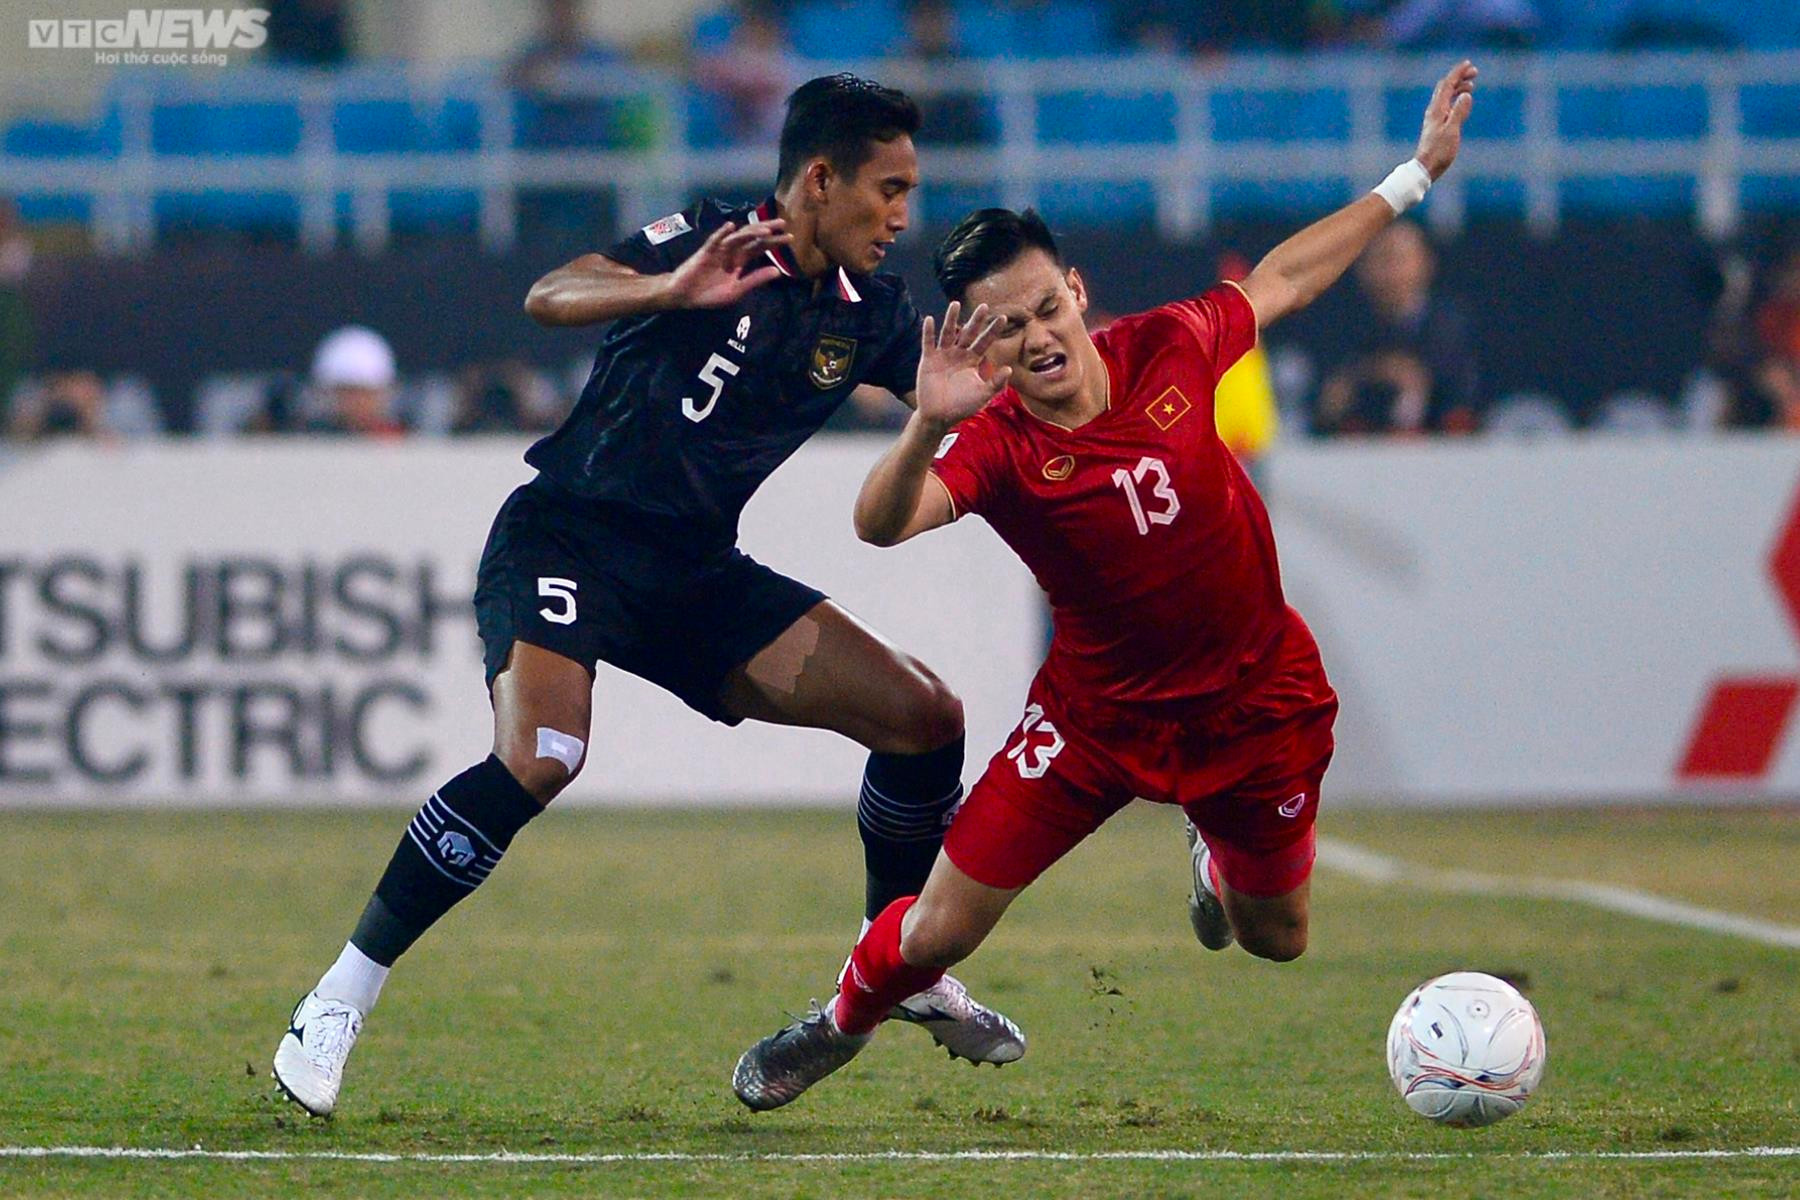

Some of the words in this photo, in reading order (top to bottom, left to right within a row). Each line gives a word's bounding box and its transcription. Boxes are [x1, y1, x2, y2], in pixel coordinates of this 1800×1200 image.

[681, 352, 741, 423] 5
[1111, 456, 1181, 535] 13
[537, 577, 578, 626] 5
[1007, 703, 1065, 779] 13
